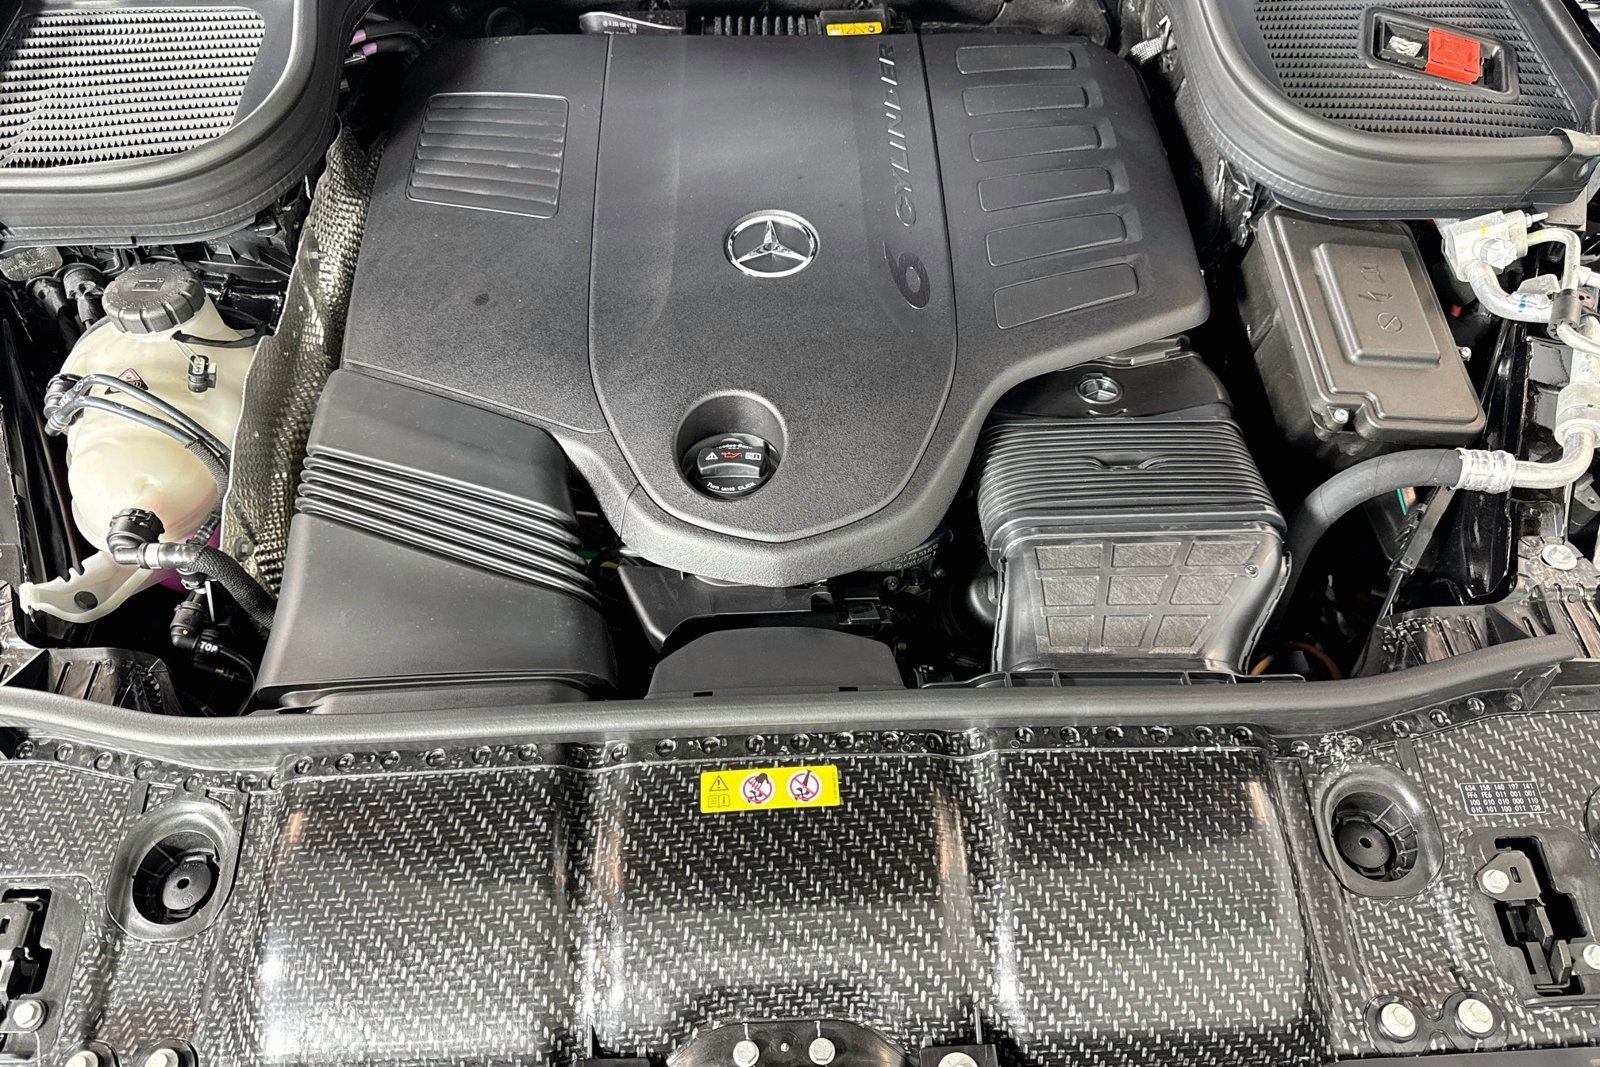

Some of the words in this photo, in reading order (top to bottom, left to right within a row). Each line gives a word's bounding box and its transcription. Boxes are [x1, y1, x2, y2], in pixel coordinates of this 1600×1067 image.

[878, 42, 917, 227] CYLINDER
[883, 240, 931, 310] 6
[706, 482, 720, 490] Turn
[738, 482, 756, 490] CLICK
[200, 641, 218, 653] TOP
